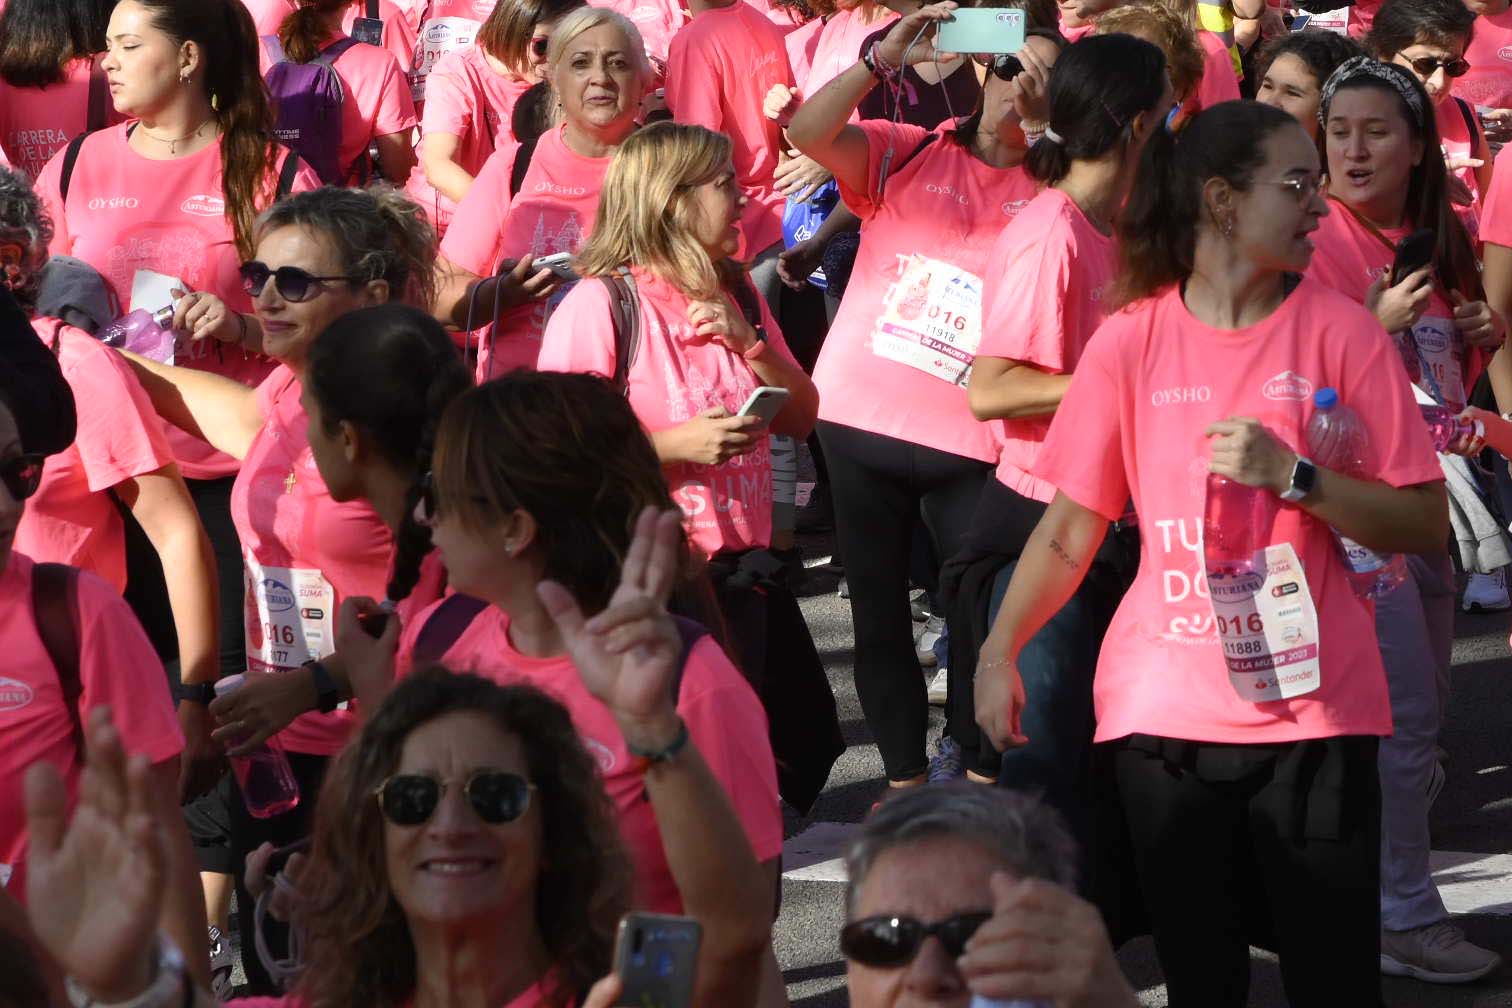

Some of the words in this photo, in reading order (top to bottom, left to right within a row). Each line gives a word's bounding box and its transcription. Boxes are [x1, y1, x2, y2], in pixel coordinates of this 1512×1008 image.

[535, 183, 586, 195] OYSHO
[88, 198, 139, 210] OYSHO
[926, 304, 968, 332] 016
[1151, 385, 1211, 407] OYSHO
[1217, 612, 1264, 635] 016
